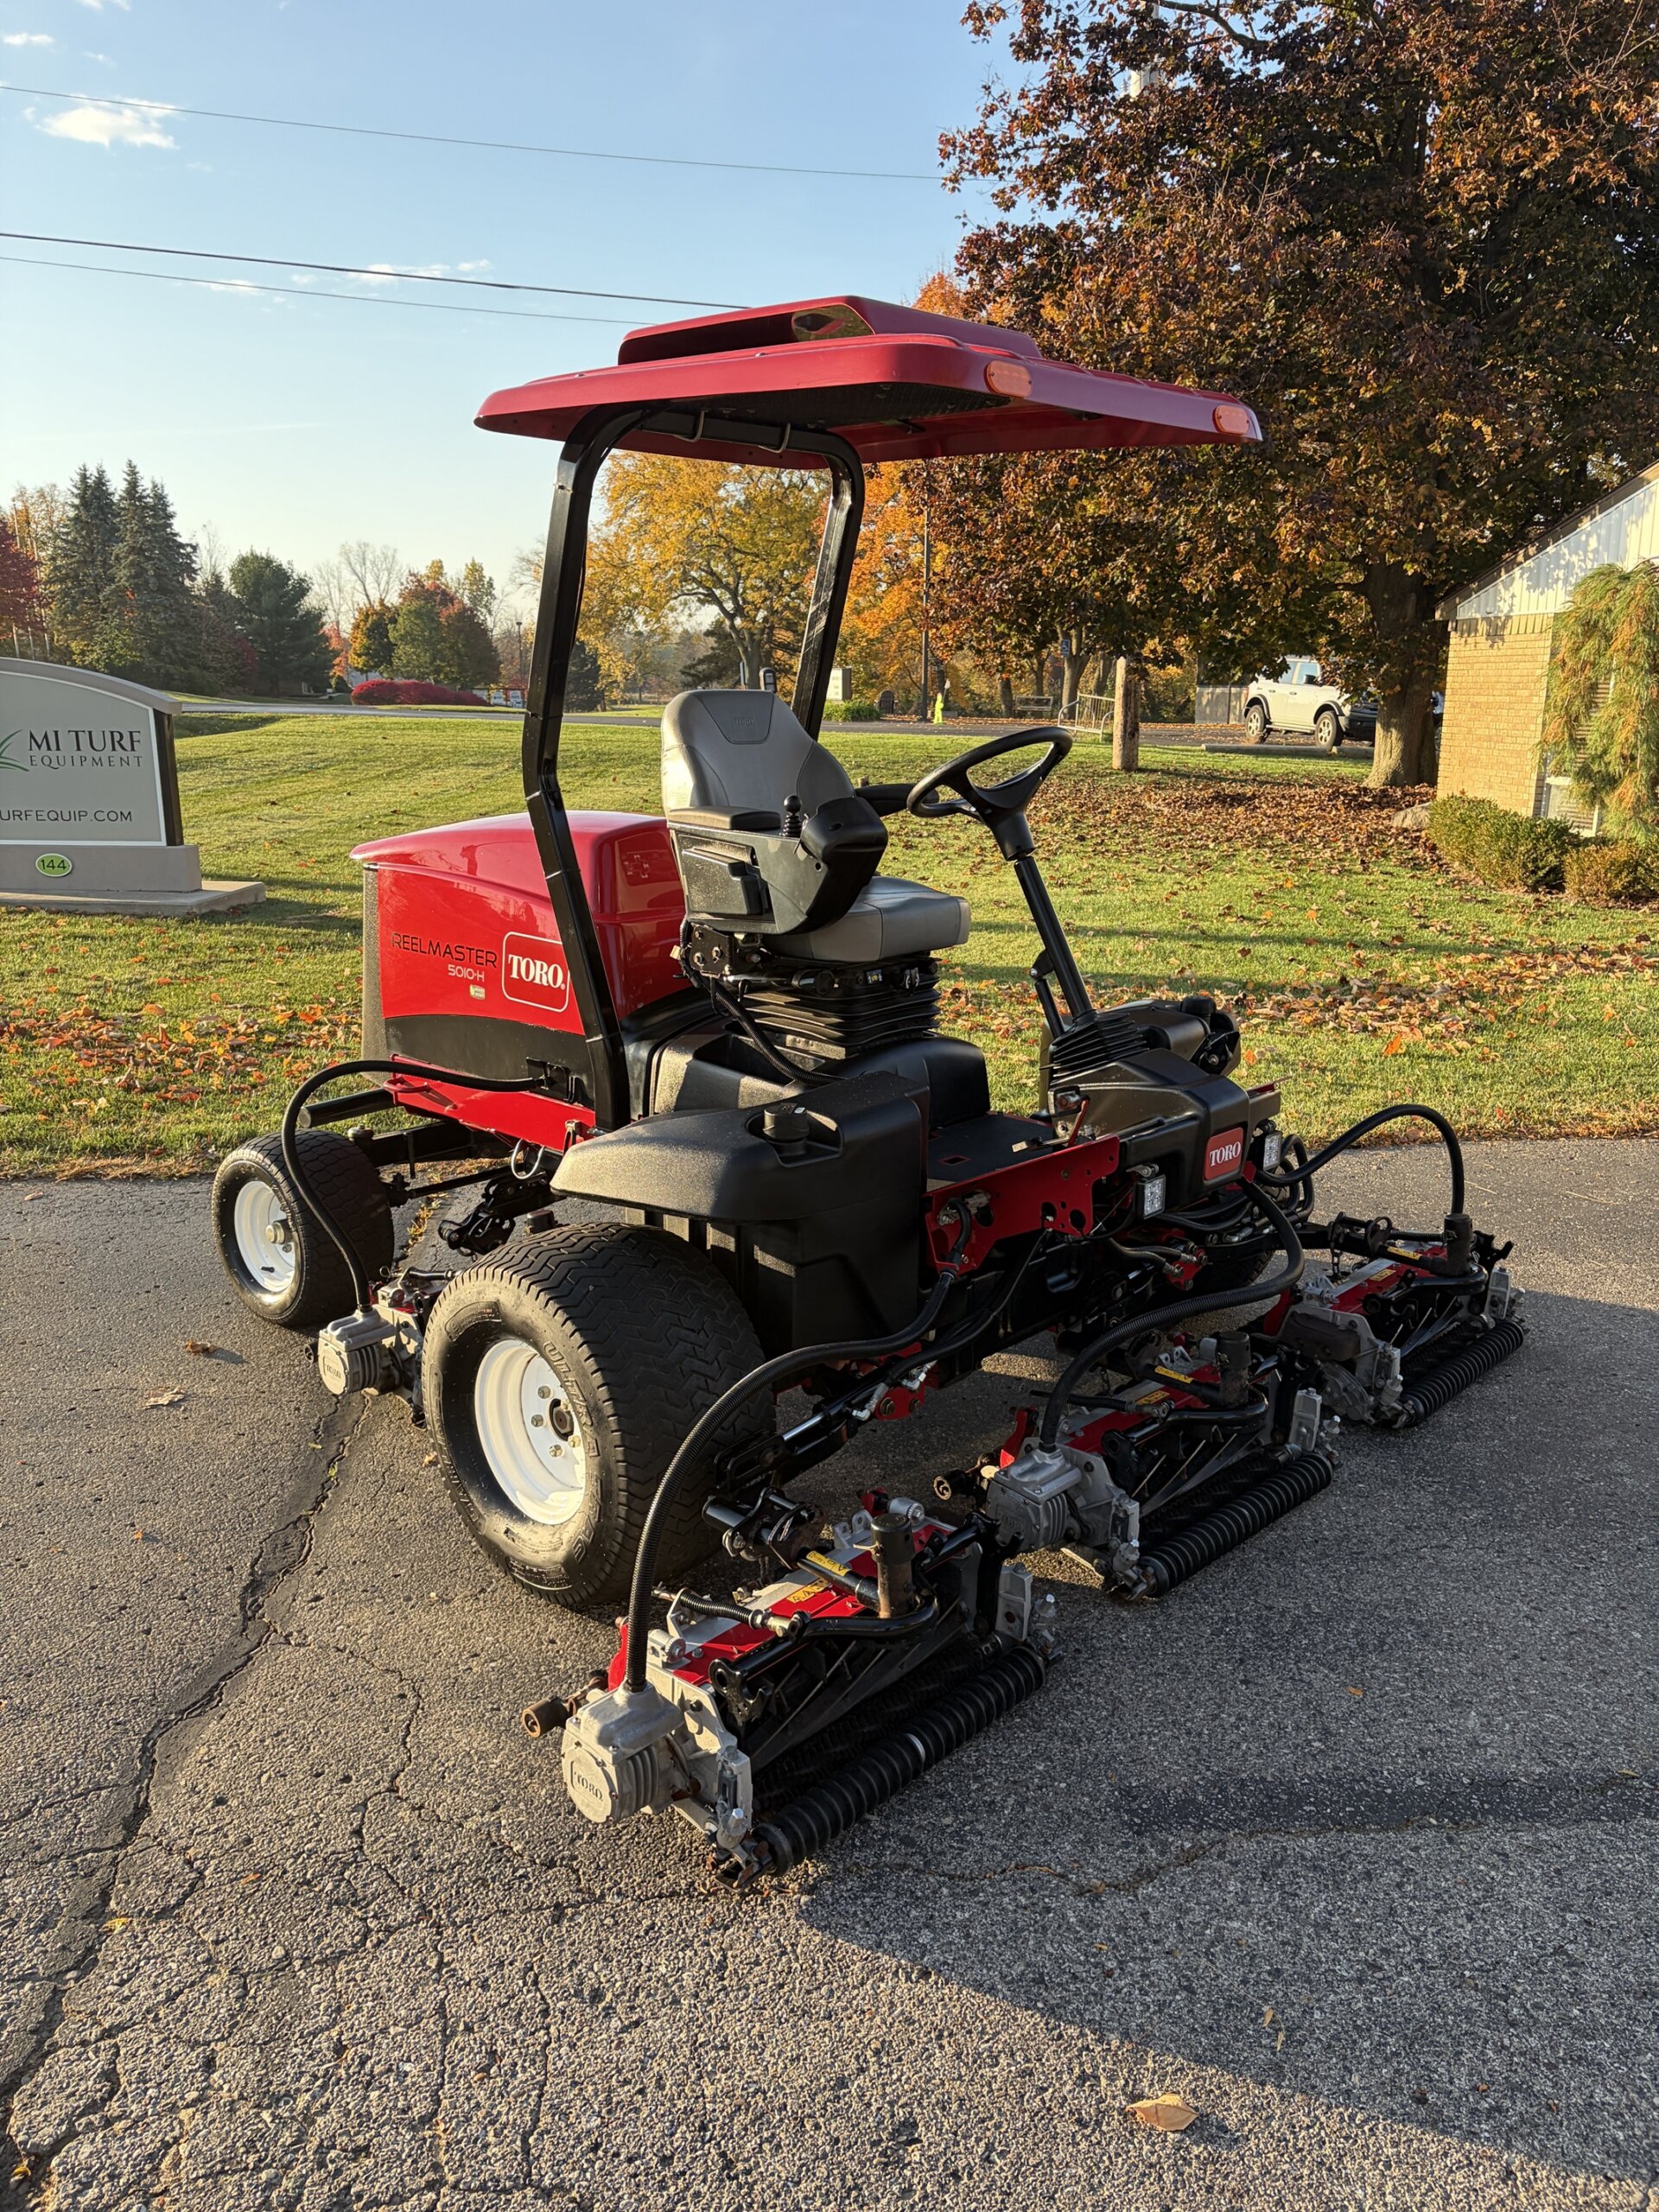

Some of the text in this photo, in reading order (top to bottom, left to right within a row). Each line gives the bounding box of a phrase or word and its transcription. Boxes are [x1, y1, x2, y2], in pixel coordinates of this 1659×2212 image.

[28, 729, 141, 752] MI TURF
[29, 754, 143, 770] EQUIPMENT
[41, 859, 67, 871] 144
[391, 932, 498, 969] REELMASTER
[1210, 1141, 1241, 1166] TORO
